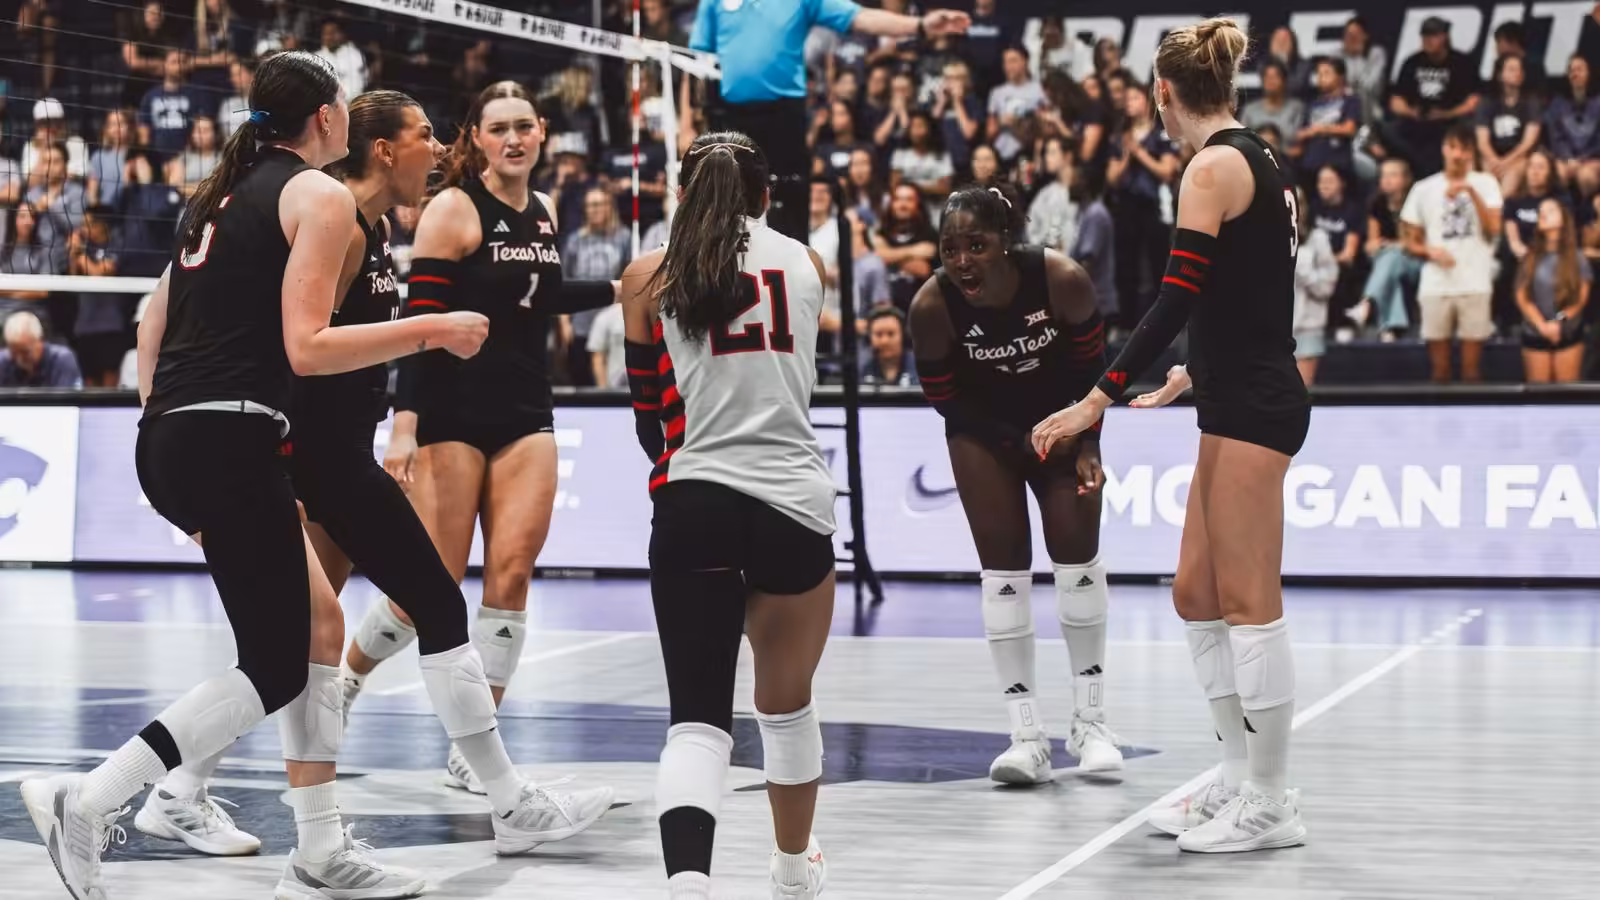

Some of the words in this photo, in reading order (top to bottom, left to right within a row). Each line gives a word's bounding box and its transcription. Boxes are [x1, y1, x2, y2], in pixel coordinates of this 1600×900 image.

[519, 272, 540, 309] 1
[708, 268, 794, 357] 21
[962, 342, 1018, 361] Texas
[1012, 326, 1060, 355] Tech
[1100, 464, 1461, 528] MOGAN
[1486, 464, 1600, 529] FA
